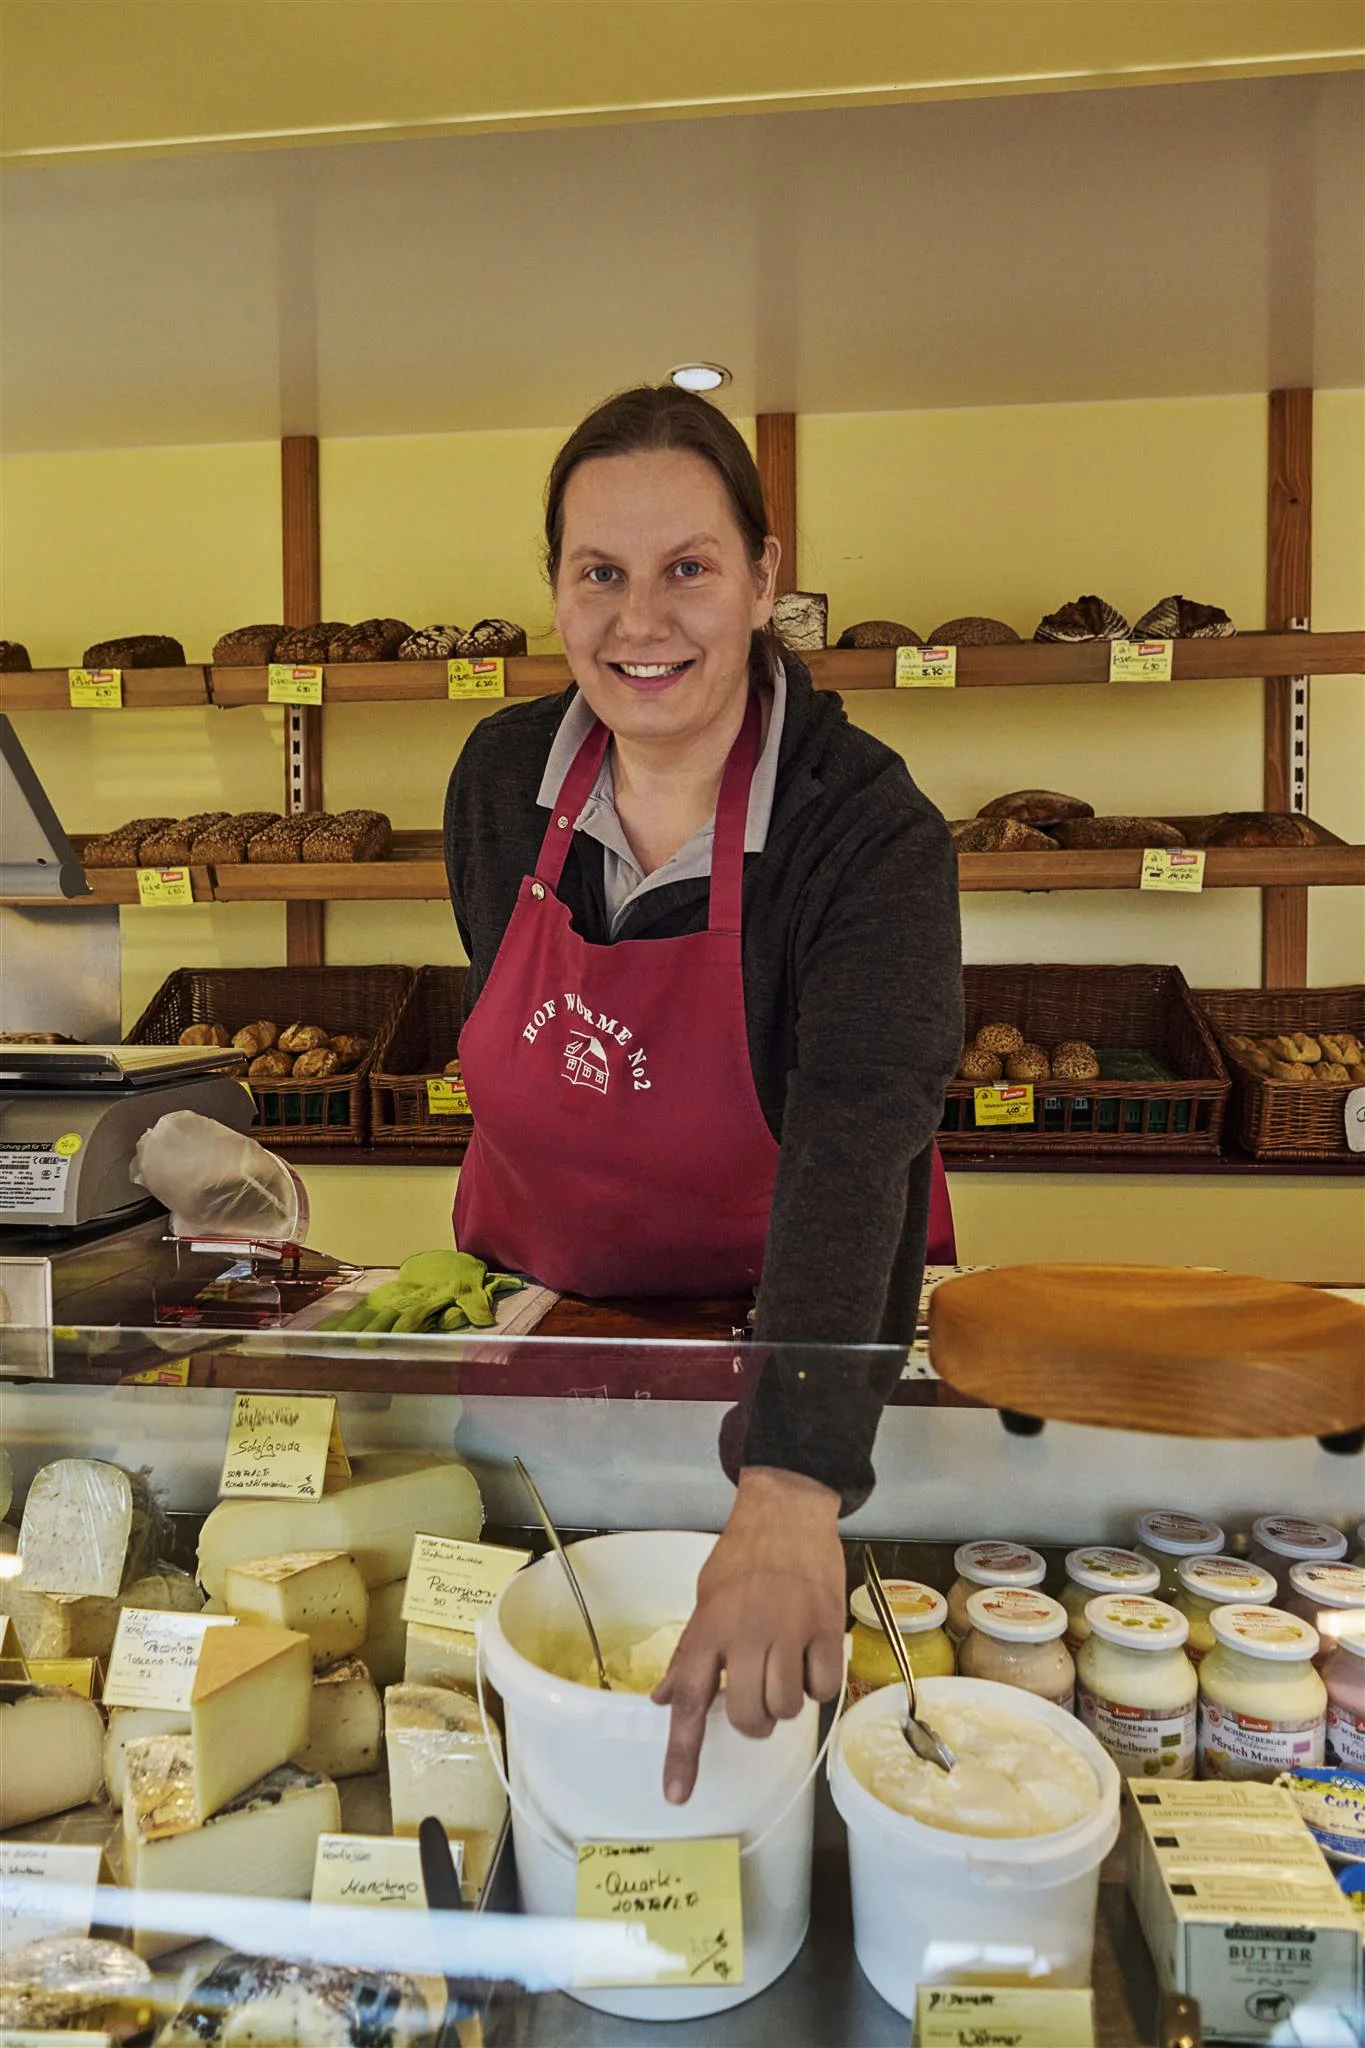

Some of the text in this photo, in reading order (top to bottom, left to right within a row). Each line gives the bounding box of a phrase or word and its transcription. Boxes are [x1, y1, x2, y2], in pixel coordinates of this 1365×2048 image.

[523, 1000, 556, 1044] HOF
[1002, 1091, 1025, 1099] demeter
[232, 1436, 301, 1460] Schafgouda
[1114, 1707, 1141, 1719] demeter
[1240, 1718, 1269, 1730] demeter
[1097, 1732, 1159, 1758] Stachelbeere
[1211, 1733, 1248, 1757] Pfirsich
[341, 1878, 419, 1899] Manchego
[1228, 1945, 1313, 1962] BUTTER
